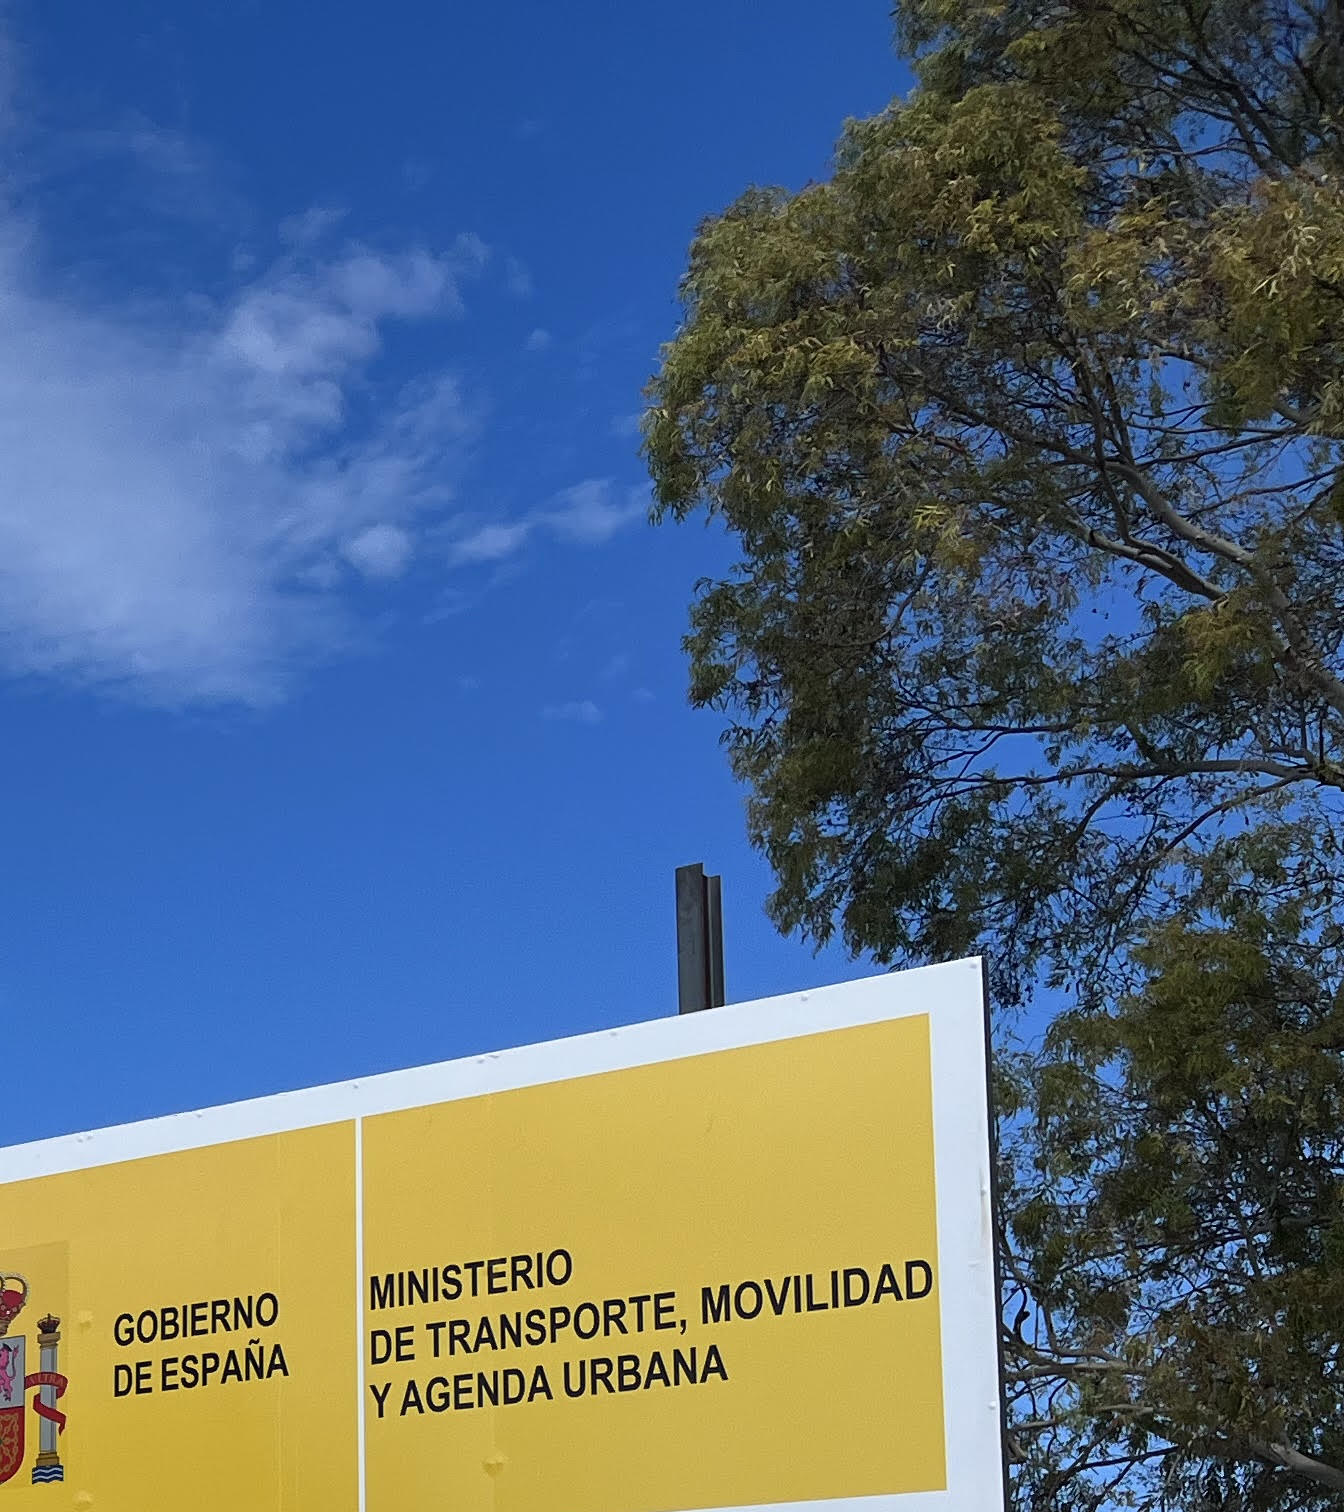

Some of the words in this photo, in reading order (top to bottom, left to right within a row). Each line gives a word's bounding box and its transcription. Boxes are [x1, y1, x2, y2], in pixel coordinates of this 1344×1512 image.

[370, 1249, 572, 1310] MINISTERIO
[114, 1292, 279, 1346] GOBIERNO
[370, 1325, 415, 1365] DE
[426, 1291, 687, 1358] TRANSPORTE,
[701, 1259, 933, 1324] MOVILIDAD
[114, 1361, 153, 1397] DE
[161, 1338, 289, 1392] ESPAÑA
[369, 1382, 391, 1418] Y
[399, 1365, 553, 1416] AGENDA
[563, 1344, 728, 1398] URBANA
